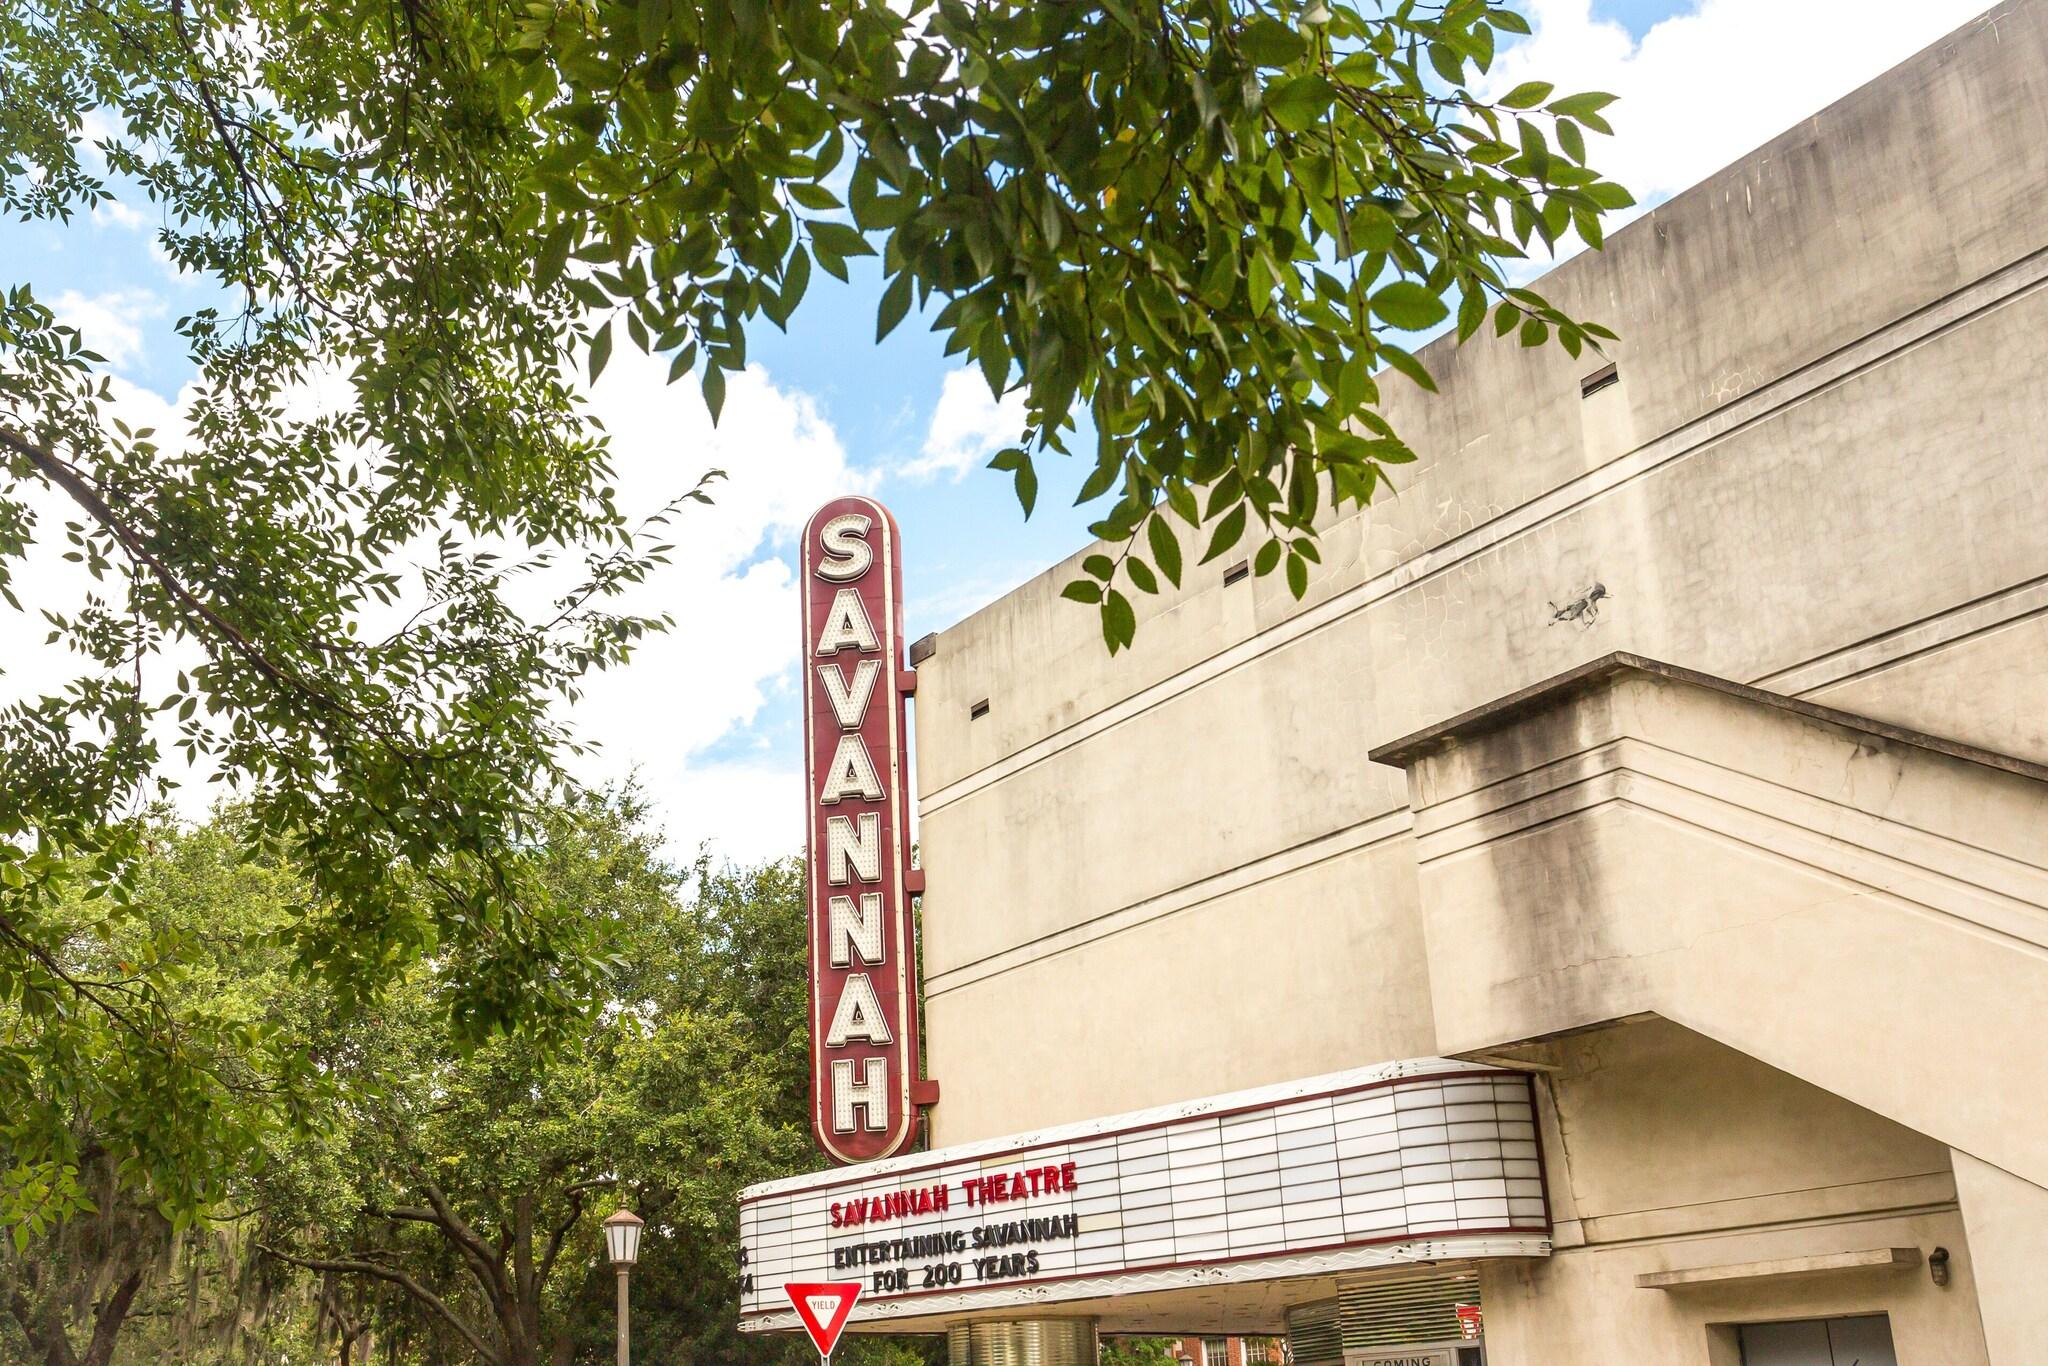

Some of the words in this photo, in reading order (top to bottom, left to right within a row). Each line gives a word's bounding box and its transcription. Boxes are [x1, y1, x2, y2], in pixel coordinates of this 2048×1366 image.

[814, 513, 893, 1134] SAVANNAH
[830, 1183, 949, 1228] SAVANNAH
[962, 1161, 1078, 1207] THEATRE
[834, 1230, 967, 1270] ENTERTAINING
[971, 1212, 1079, 1250] SAVANNAH
[873, 1267, 909, 1293] FOR
[922, 1261, 962, 1288] 200
[972, 1250, 1040, 1281] YEARS
[811, 1300, 835, 1310] YIELD
